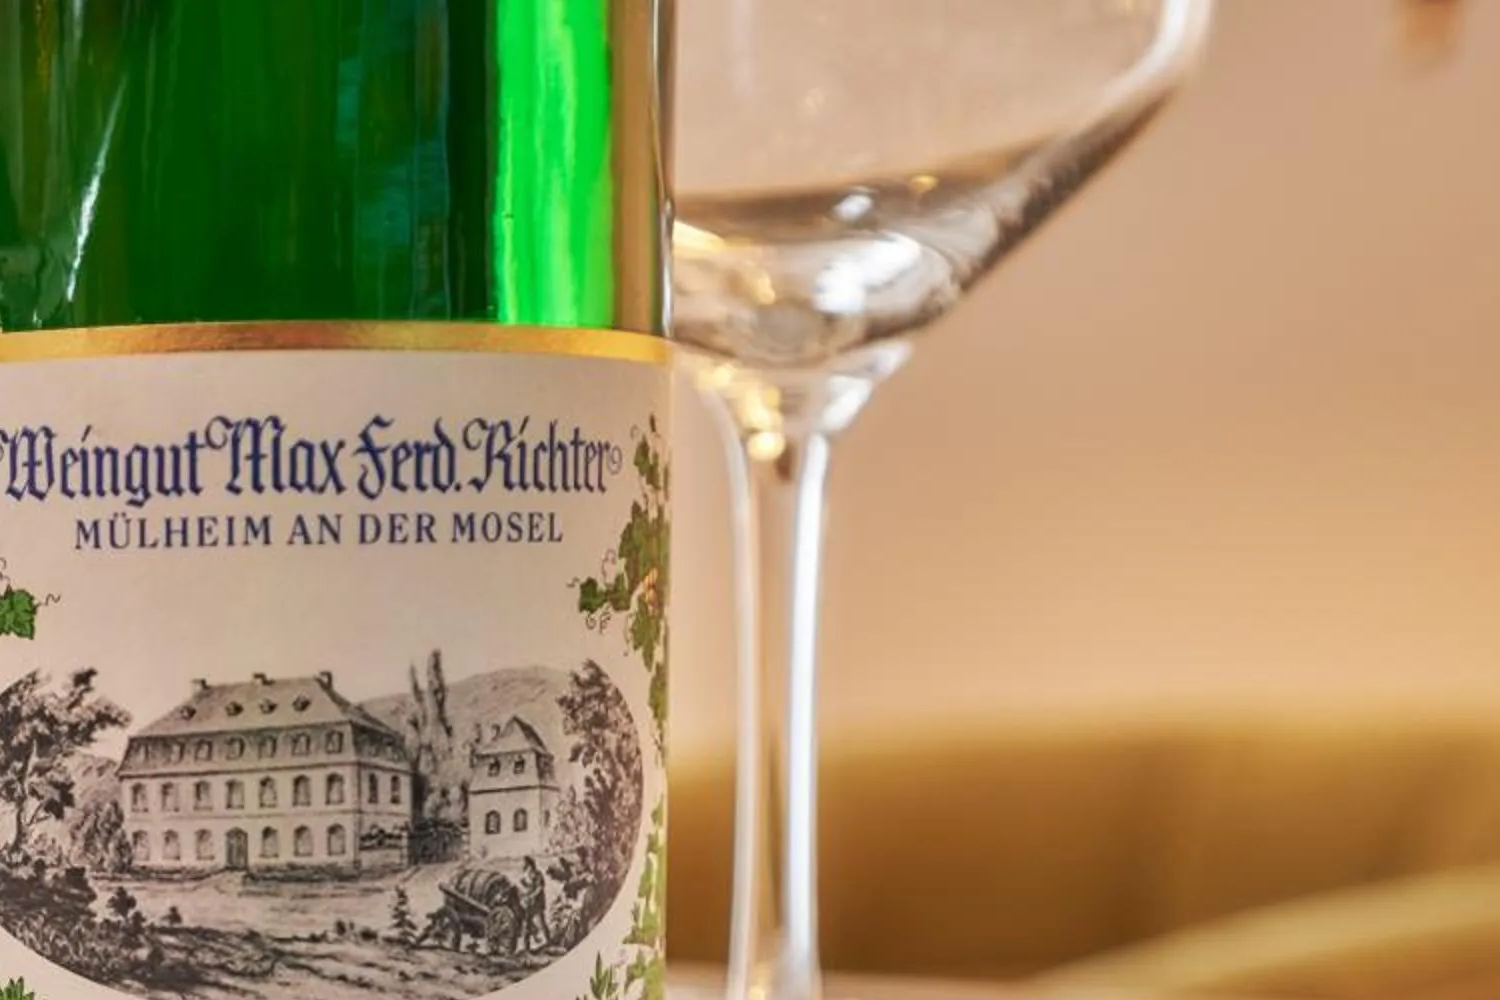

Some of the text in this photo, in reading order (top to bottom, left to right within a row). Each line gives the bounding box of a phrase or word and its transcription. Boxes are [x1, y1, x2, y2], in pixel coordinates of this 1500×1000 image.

[203, 415, 347, 496] Max
[353, 415, 462, 501] Ferd.
[460, 415, 622, 494] Richter
[75, 510, 563, 550] MÜLHEIM AN DER MOSEL
